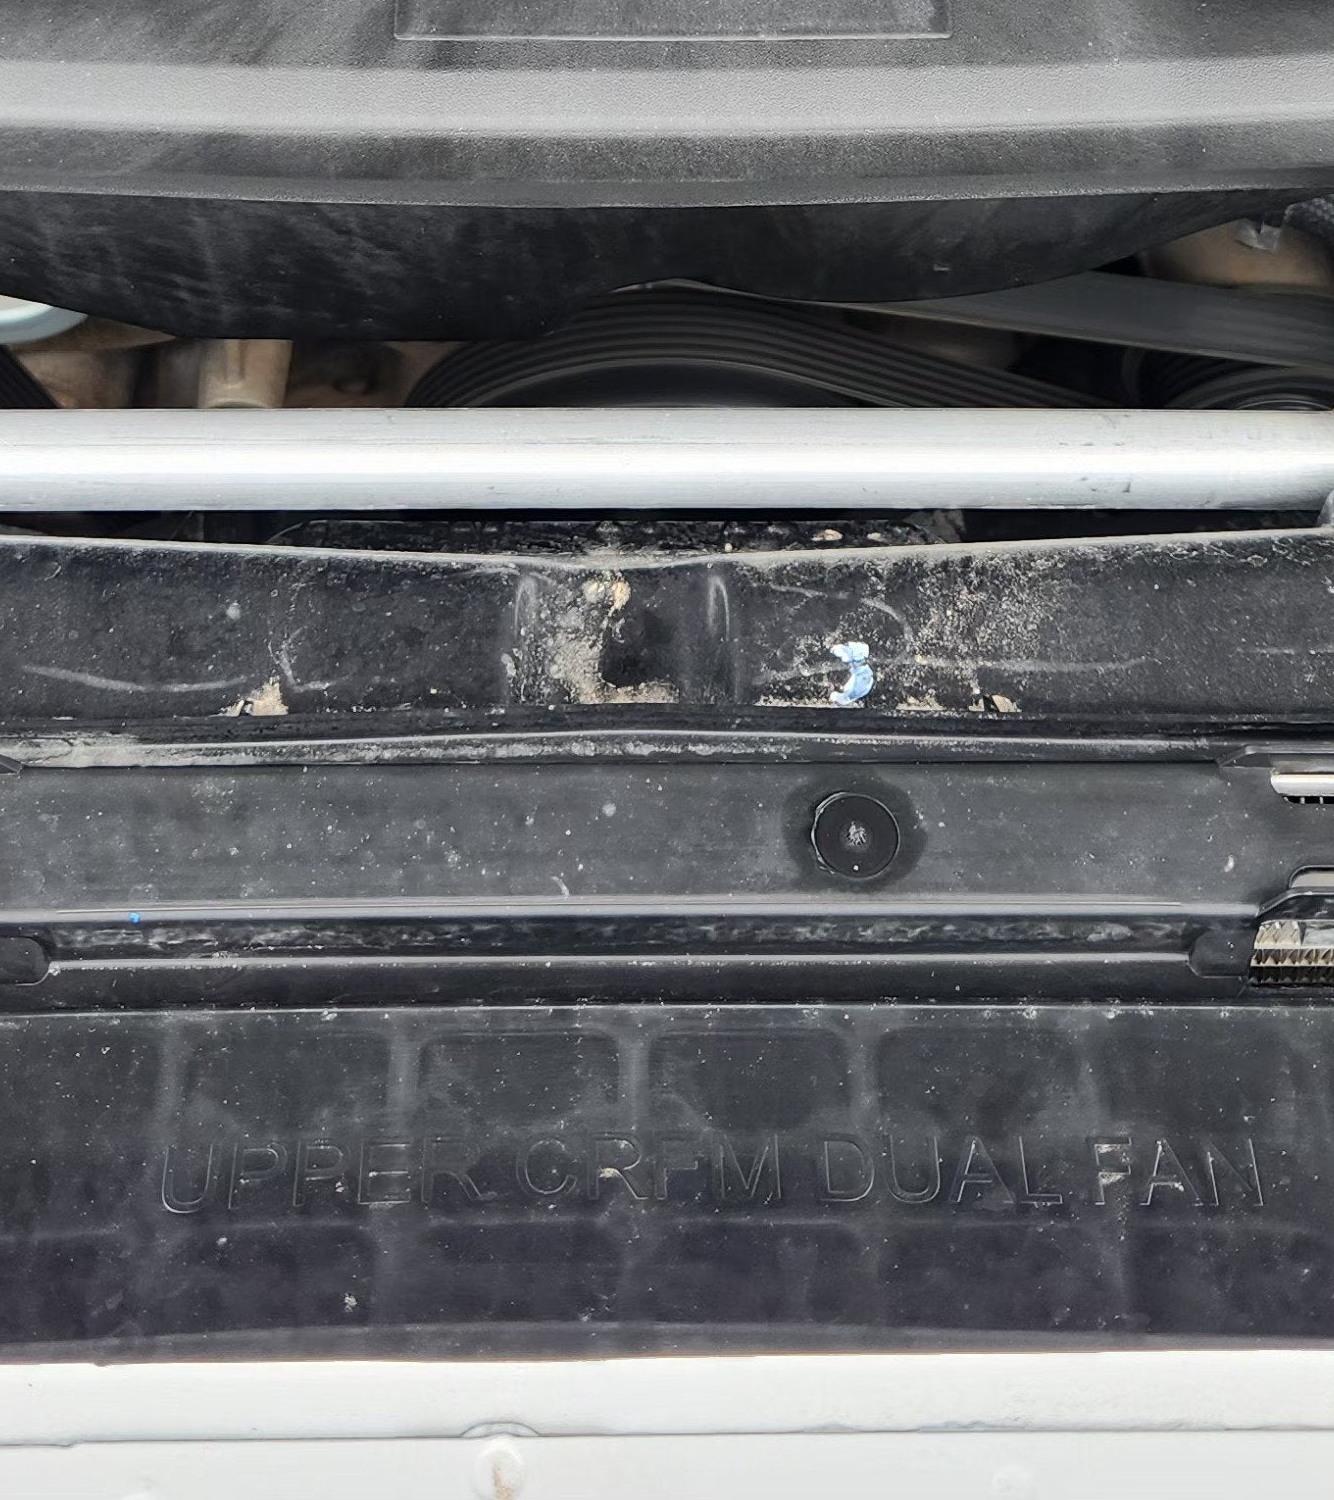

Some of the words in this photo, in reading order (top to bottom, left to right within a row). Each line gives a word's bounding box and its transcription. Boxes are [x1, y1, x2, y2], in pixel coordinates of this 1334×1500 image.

[161, 1135, 483, 1213] UPPER
[818, 1130, 1065, 1206] DUAL
[1082, 1132, 1267, 1208] FAN
